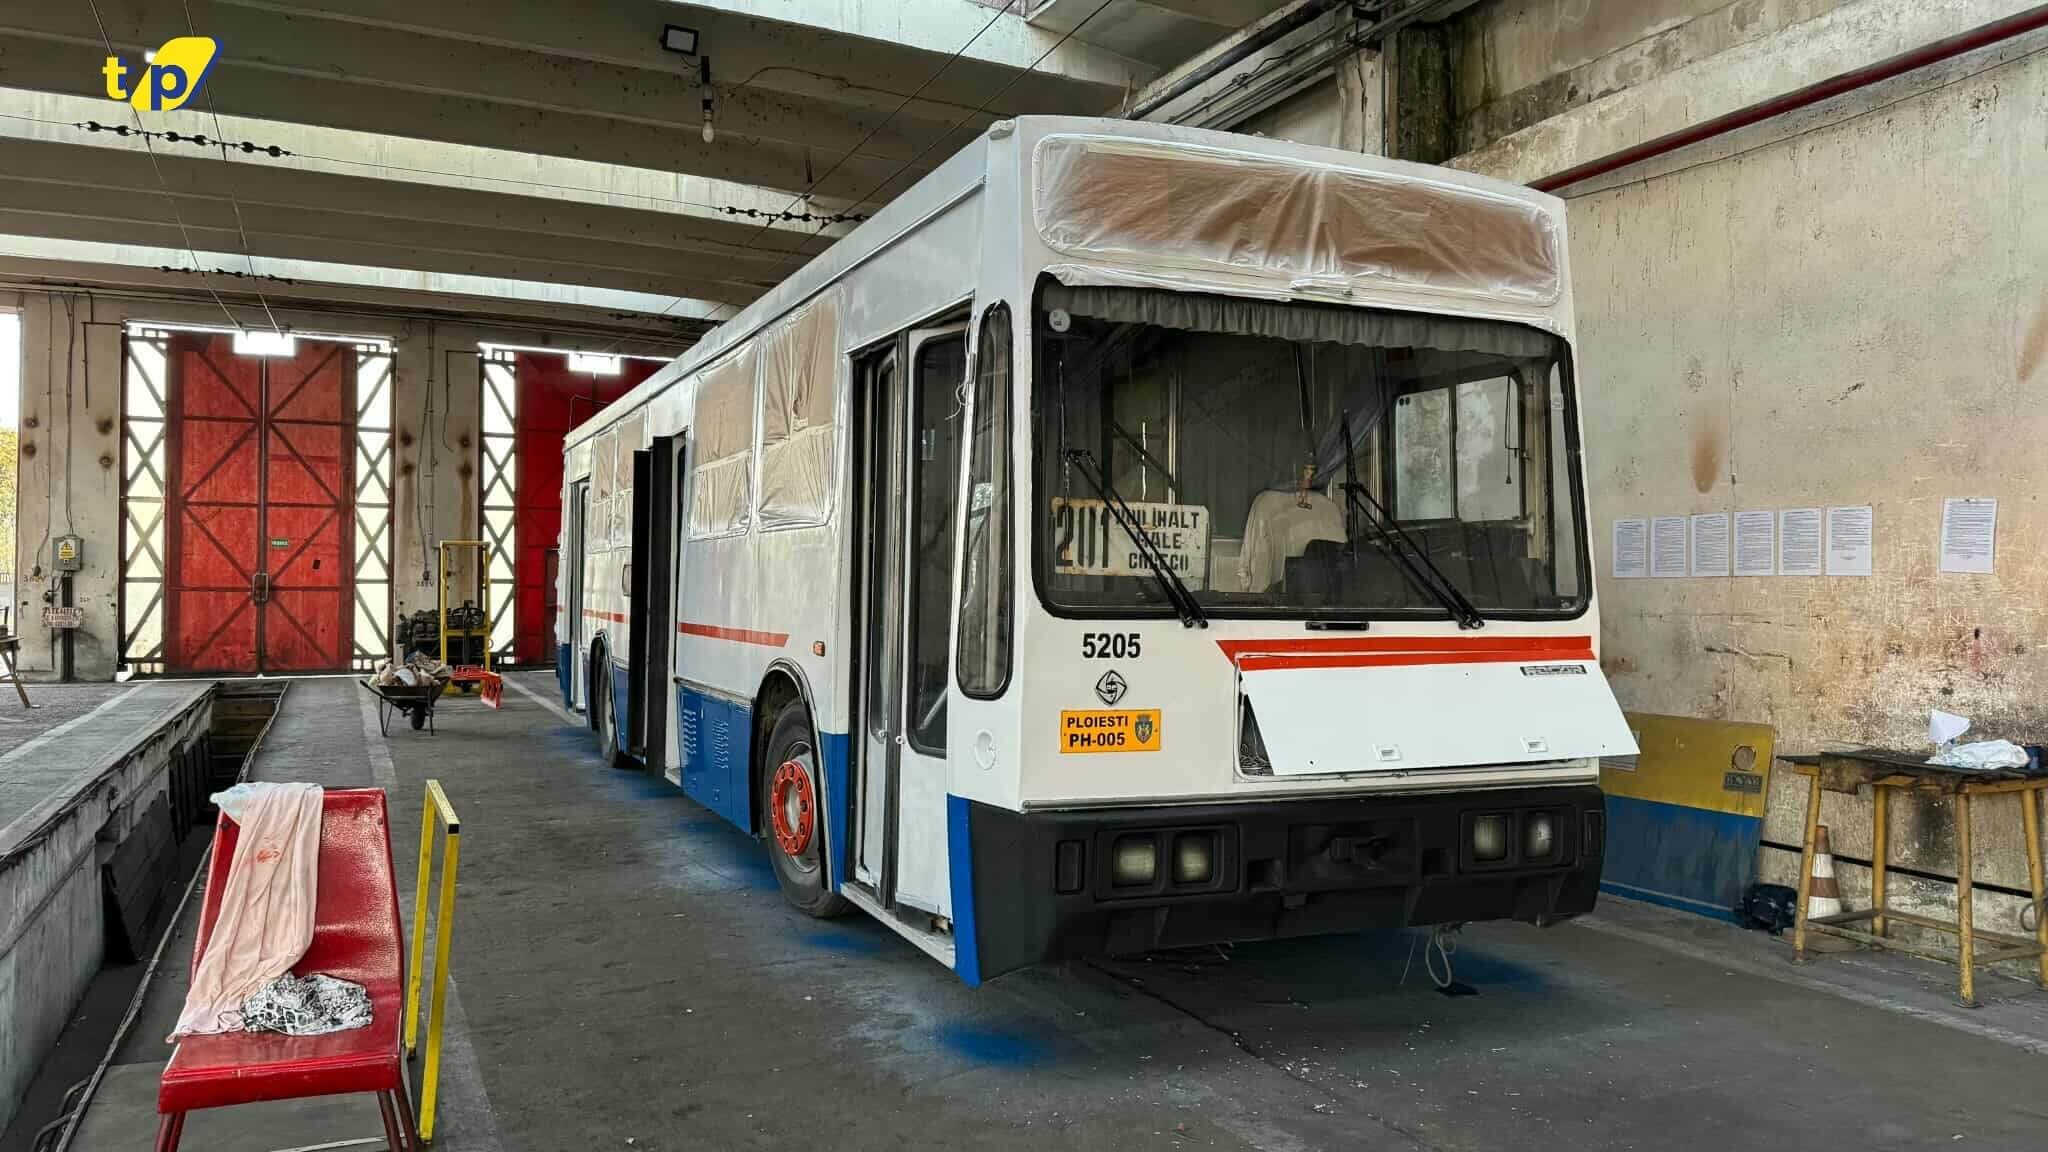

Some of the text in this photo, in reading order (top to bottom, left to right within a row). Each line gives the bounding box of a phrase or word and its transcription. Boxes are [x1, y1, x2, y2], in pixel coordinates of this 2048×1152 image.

[1056, 505, 1109, 568] 201
[1082, 633, 1141, 658] 5205
[1067, 716, 1128, 728] PLOIESTI
[1069, 732, 1125, 747] PH-005
